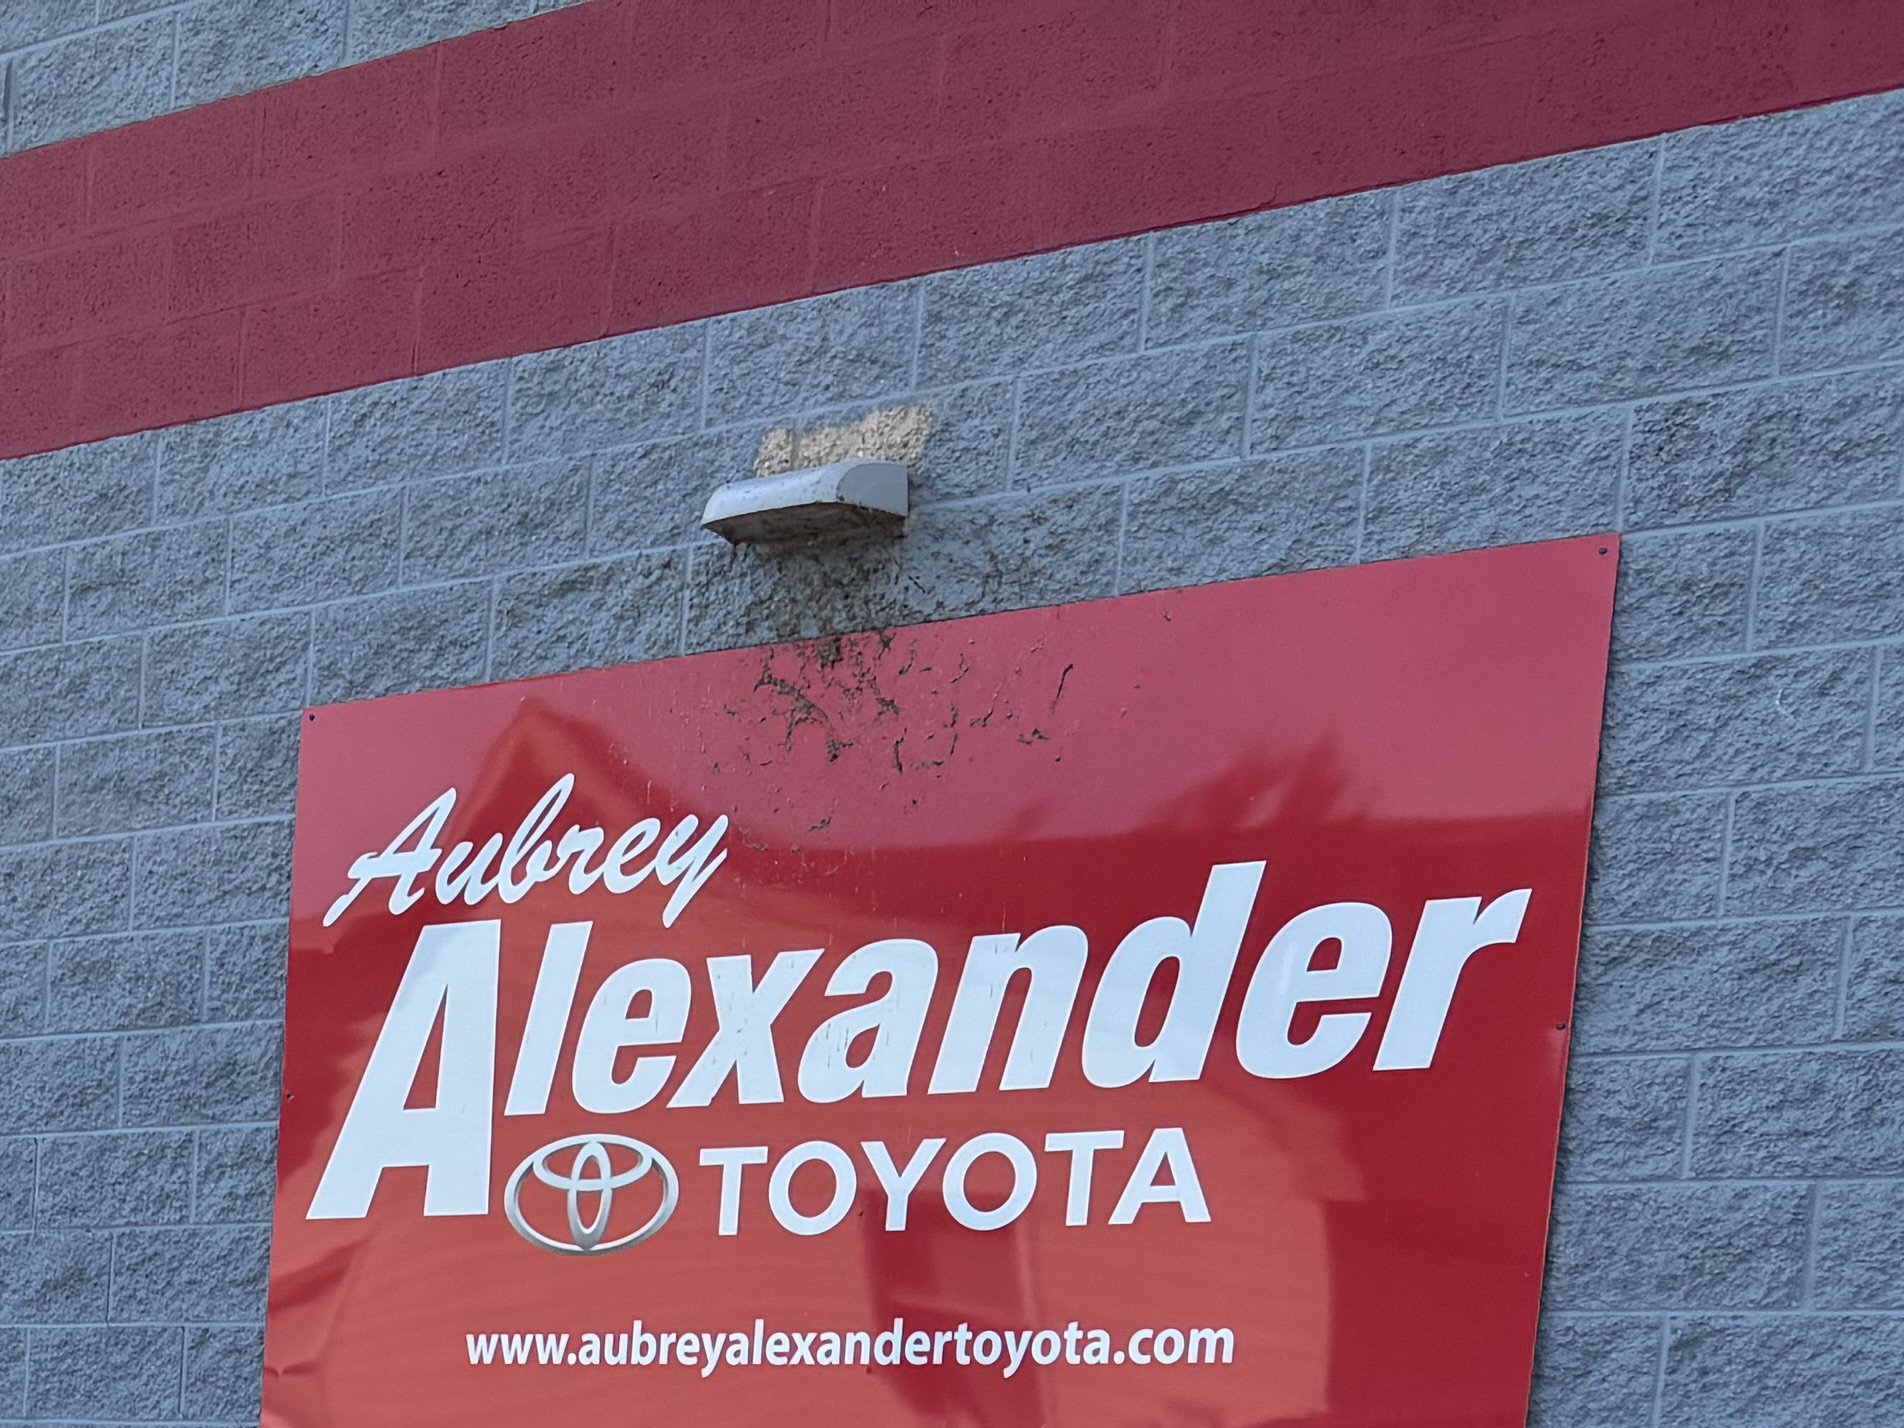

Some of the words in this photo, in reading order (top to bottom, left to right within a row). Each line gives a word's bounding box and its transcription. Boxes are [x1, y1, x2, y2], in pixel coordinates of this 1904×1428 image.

[322, 772, 729, 928] Aubrey
[305, 860, 1533, 1220] Alexander
[699, 1127, 1212, 1236] TOYOTA
[464, 1317, 1235, 1379] www.aubreyalexandertoyota.com
